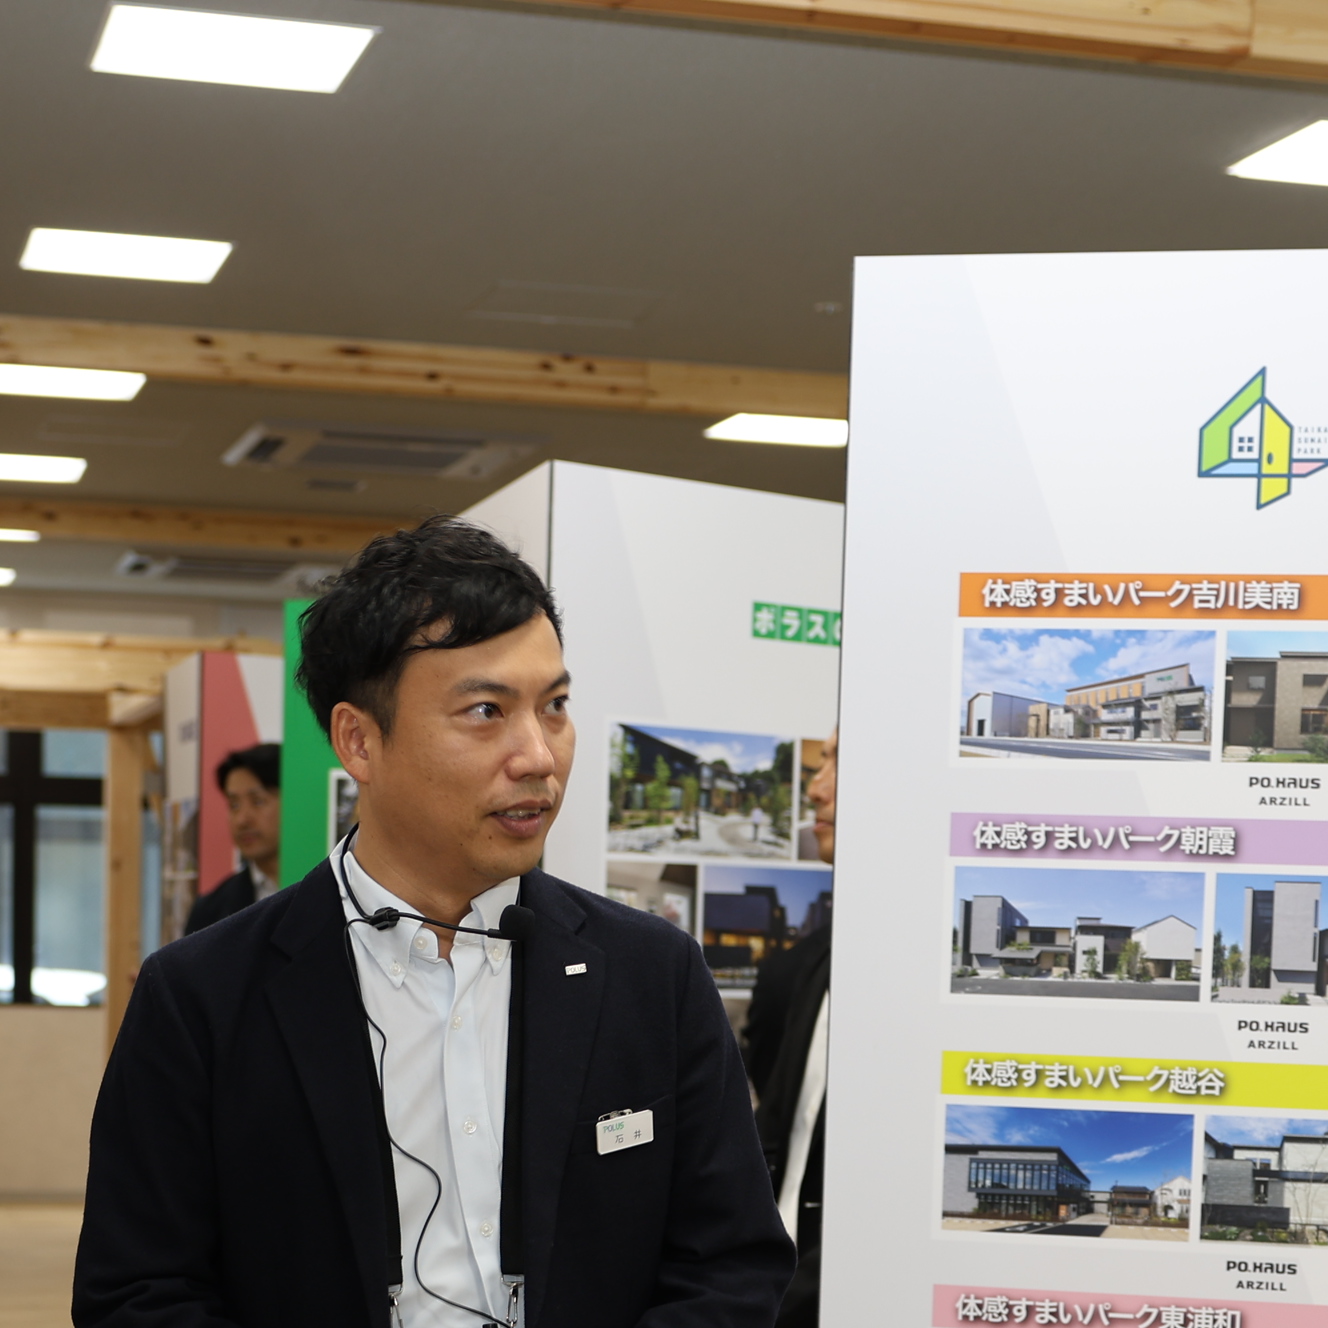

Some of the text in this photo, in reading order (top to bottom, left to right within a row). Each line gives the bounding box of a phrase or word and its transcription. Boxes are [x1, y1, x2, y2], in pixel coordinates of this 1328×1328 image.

[981, 578, 1302, 611] 体感すまいパーク吉川美南
[1258, 796, 1310, 807] ARZILL
[973, 821, 1236, 857] 体感すまいパーク朝霞
[1247, 1039, 1299, 1051] ARZILL
[964, 1059, 1226, 1096] 体感すまいパーク越谷
[602, 1121, 625, 1134] POLUS
[1235, 1280, 1287, 1292] ARZILL
